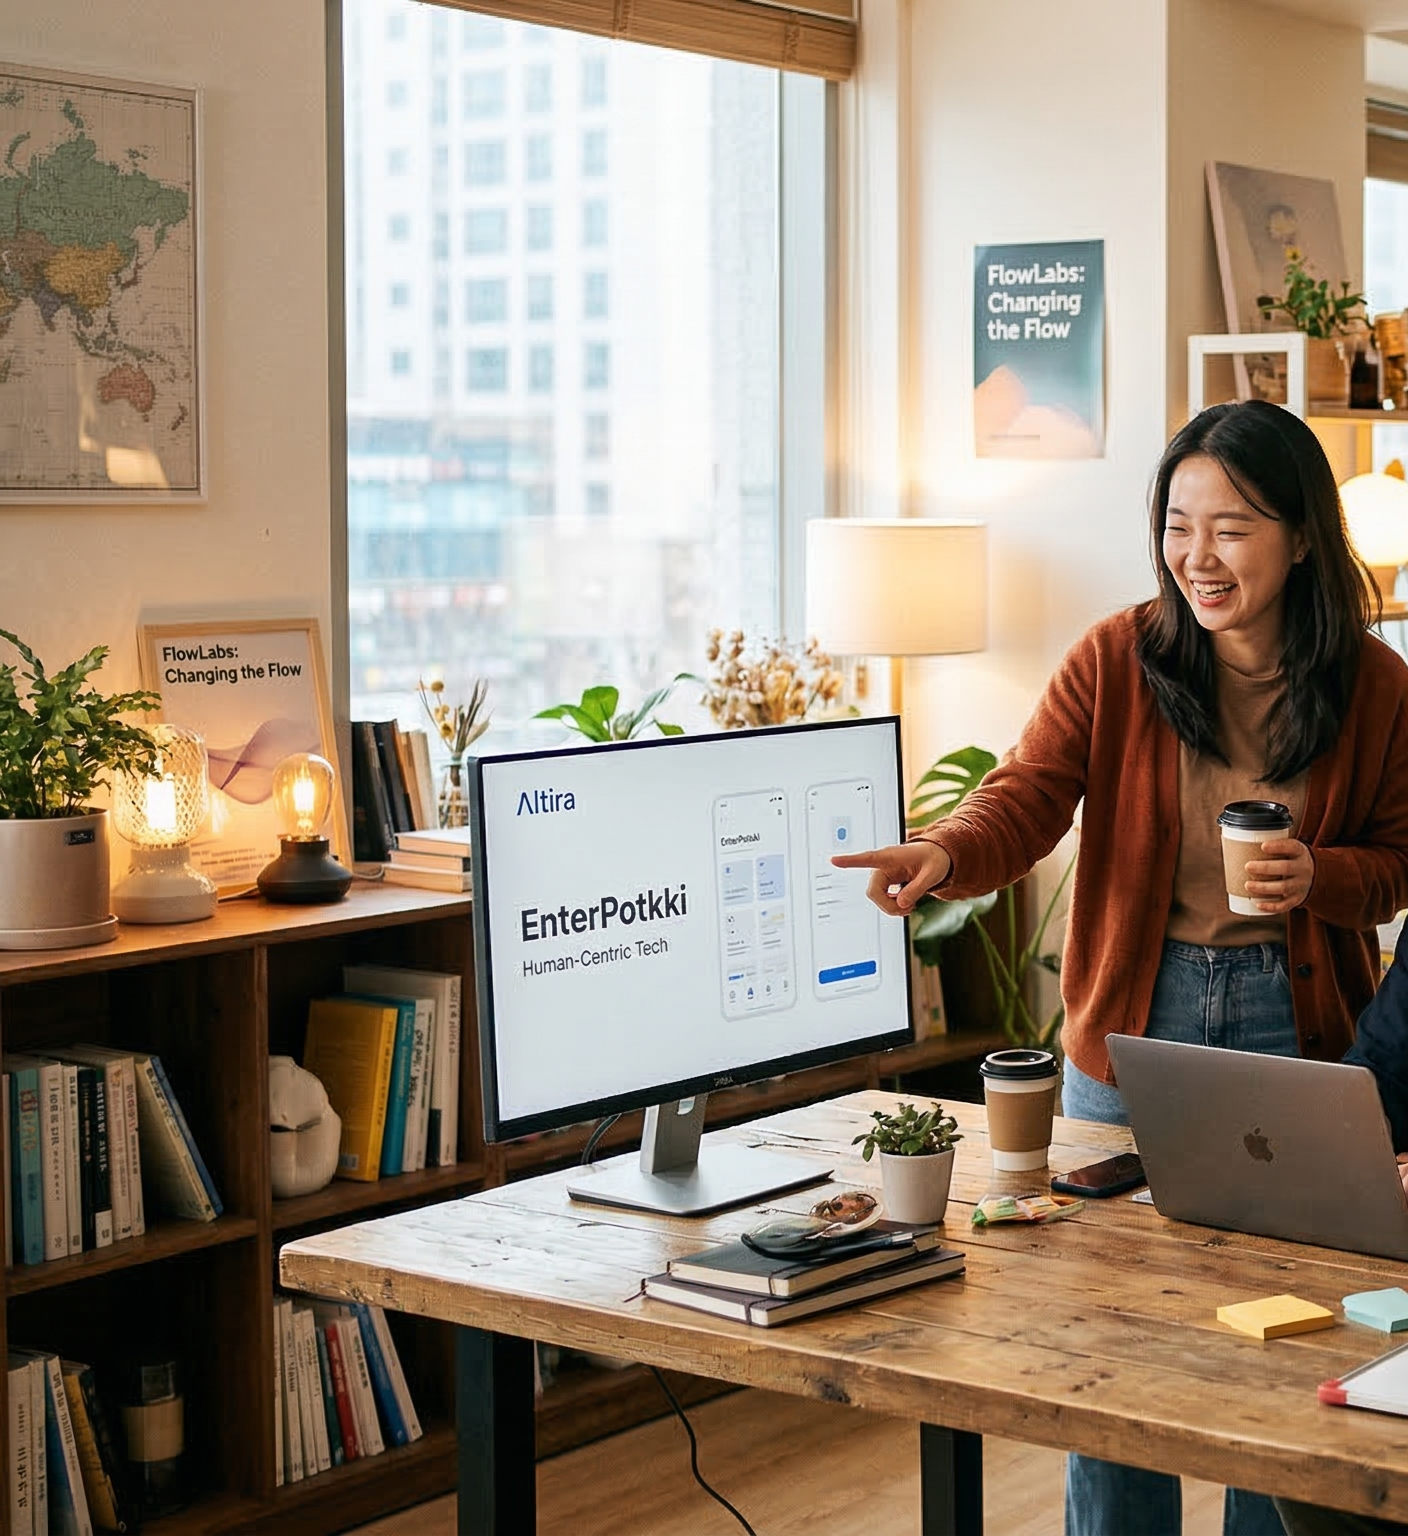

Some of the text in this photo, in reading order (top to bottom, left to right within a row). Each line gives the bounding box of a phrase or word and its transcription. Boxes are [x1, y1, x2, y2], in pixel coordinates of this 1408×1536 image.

[987, 262, 1085, 286] FlowLabs:
[987, 290, 1082, 316] Changing
[987, 317, 1071, 340] the Flow
[162, 644, 239, 662] FlowLabs:
[165, 662, 302, 685] Changing the Flow
[516, 788, 576, 816] Altira
[521, 883, 688, 942] EnterPotkki
[523, 938, 668, 977] Human-Centric Tech
